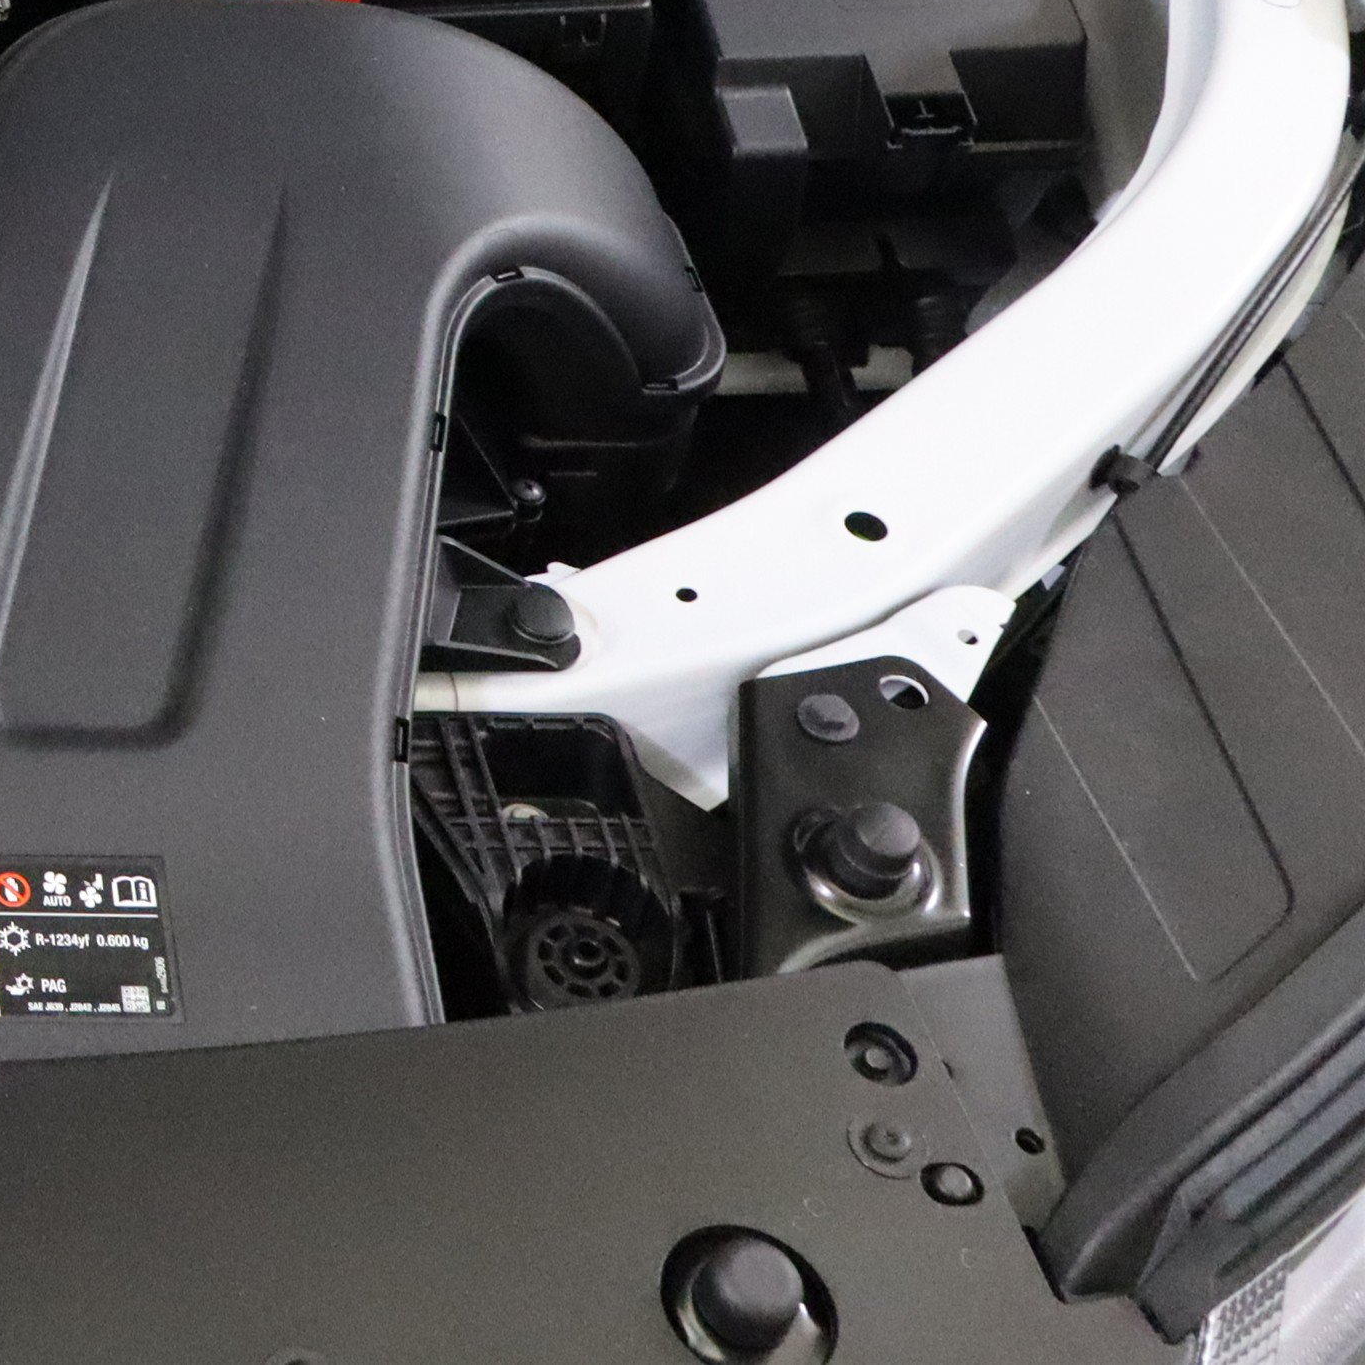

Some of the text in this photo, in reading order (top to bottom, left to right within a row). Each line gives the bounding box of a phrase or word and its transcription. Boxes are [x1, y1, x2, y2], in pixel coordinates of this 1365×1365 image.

[43, 895, 71, 907] AUTO
[35, 934, 149, 950] R-1234yf 0.600 kg
[41, 978, 67, 993] PAG
[27, 1001, 44, 1012] SAE
